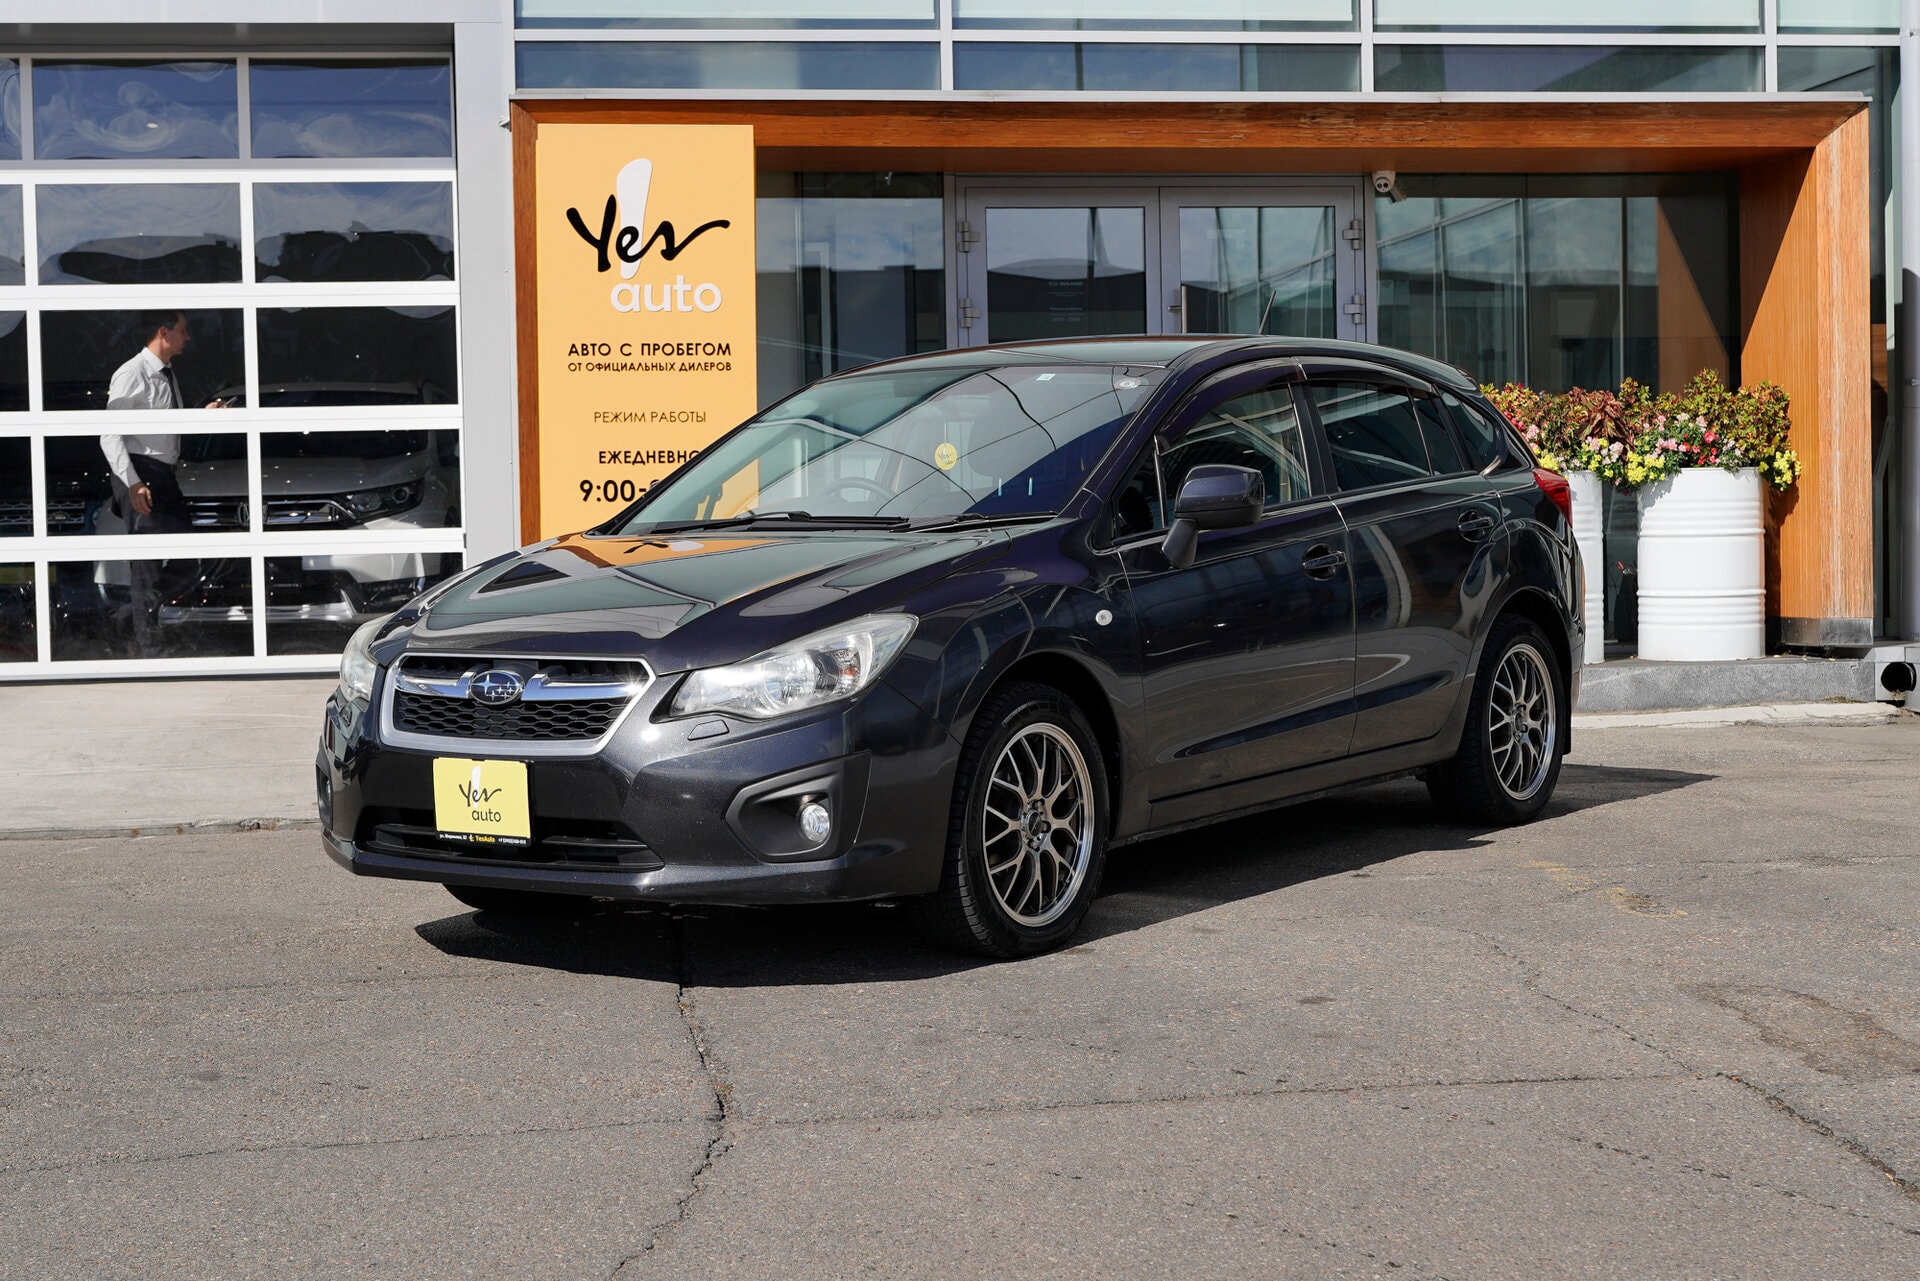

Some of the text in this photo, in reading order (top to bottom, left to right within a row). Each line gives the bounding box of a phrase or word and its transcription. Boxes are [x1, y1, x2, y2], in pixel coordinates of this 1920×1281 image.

[566, 194, 731, 273] Yes
[610, 274, 723, 313] auto
[567, 342, 732, 357] АВТО С ПРОБЕГОМ
[567, 361, 732, 373] ОТ ОФИЦИАЛЬНЫХ ДИЛЕРОВ
[593, 411, 707, 424] РЕЖИМ РАБОТЫ
[459, 780, 502, 807] Yes
[471, 808, 502, 822] auto
